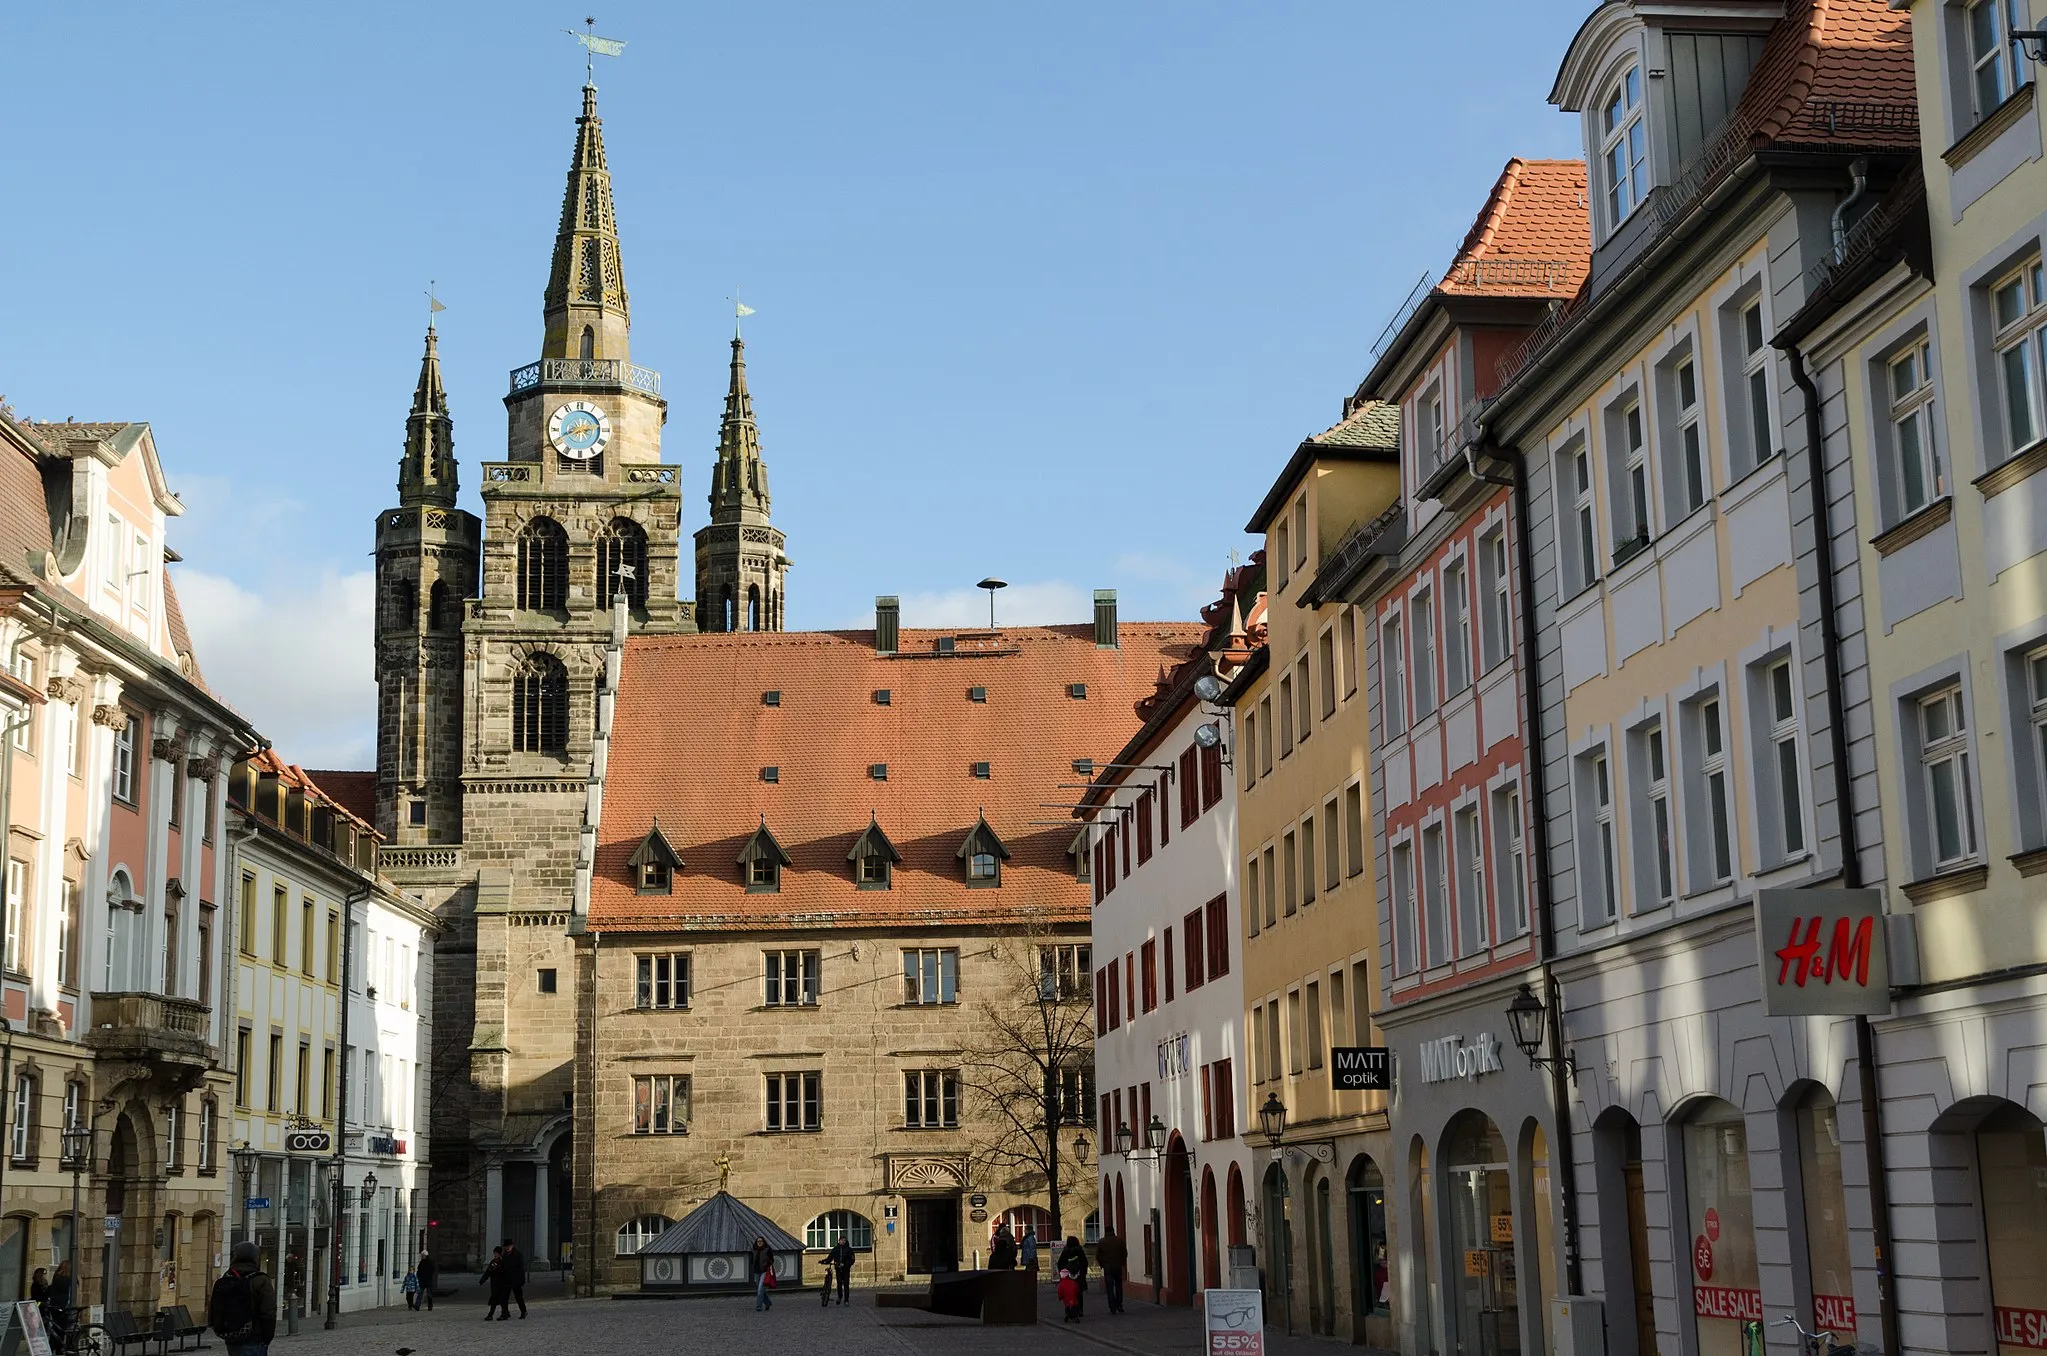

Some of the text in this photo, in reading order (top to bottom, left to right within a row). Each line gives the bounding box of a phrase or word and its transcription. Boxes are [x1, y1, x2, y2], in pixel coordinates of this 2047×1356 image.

[1775, 916, 1874, 988] H&M
[1337, 1052, 1385, 1069] MATT
[1343, 1072, 1379, 1086] optik
[1698, 1249, 1711, 1268] 5€
[1695, 1289, 1762, 1319] SALE SALE
[1815, 1297, 1854, 1328] SALE
[1212, 1335, 1259, 1349] 55%
